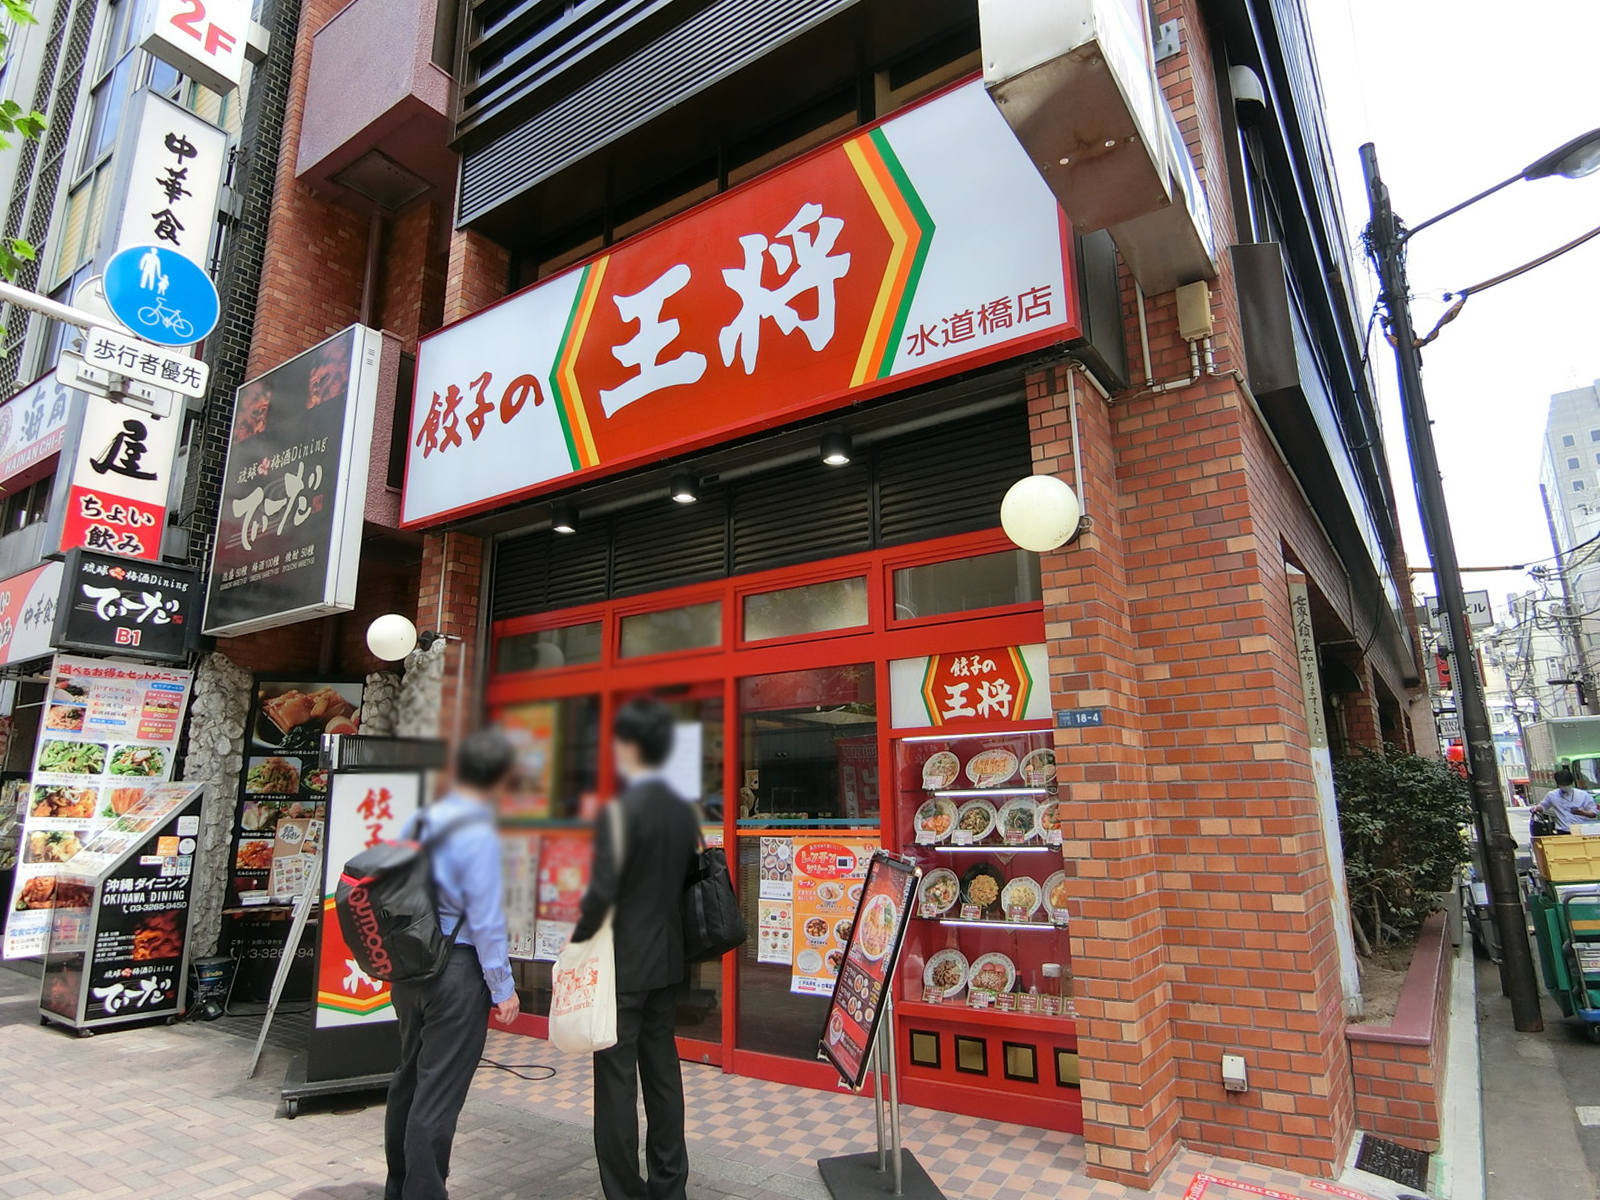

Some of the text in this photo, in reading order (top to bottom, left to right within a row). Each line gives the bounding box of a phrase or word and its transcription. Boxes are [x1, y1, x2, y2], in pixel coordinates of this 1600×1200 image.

[169, 0, 237, 56] 2F
[151, 132, 198, 246] 中華食
[414, 202, 852, 459] 餃子の 王将
[905, 284, 1054, 358] 水道橋店
[93, 338, 203, 390] 歩行者優先
[4, 445, 39, 475] HAINAN
[88, 419, 159, 482] 屋
[80, 493, 156, 527] ちょい
[86, 526, 145, 556] 飲み
[115, 627, 142, 646] B1
[58, 664, 189, 682] 選べるお得なセットメニュー
[950, 655, 997, 676] 餃子の
[942, 678, 1013, 721] 王将
[1076, 713, 1099, 723] 18-4
[801, 851, 837, 864] レンチン
[102, 889, 185, 906] OKINAWA DINING
[105, 875, 190, 893] 沖縄ダイニング
[129, 901, 188, 913] 03-3265-9450
[347, 887, 393, 976] OUTDOOR
